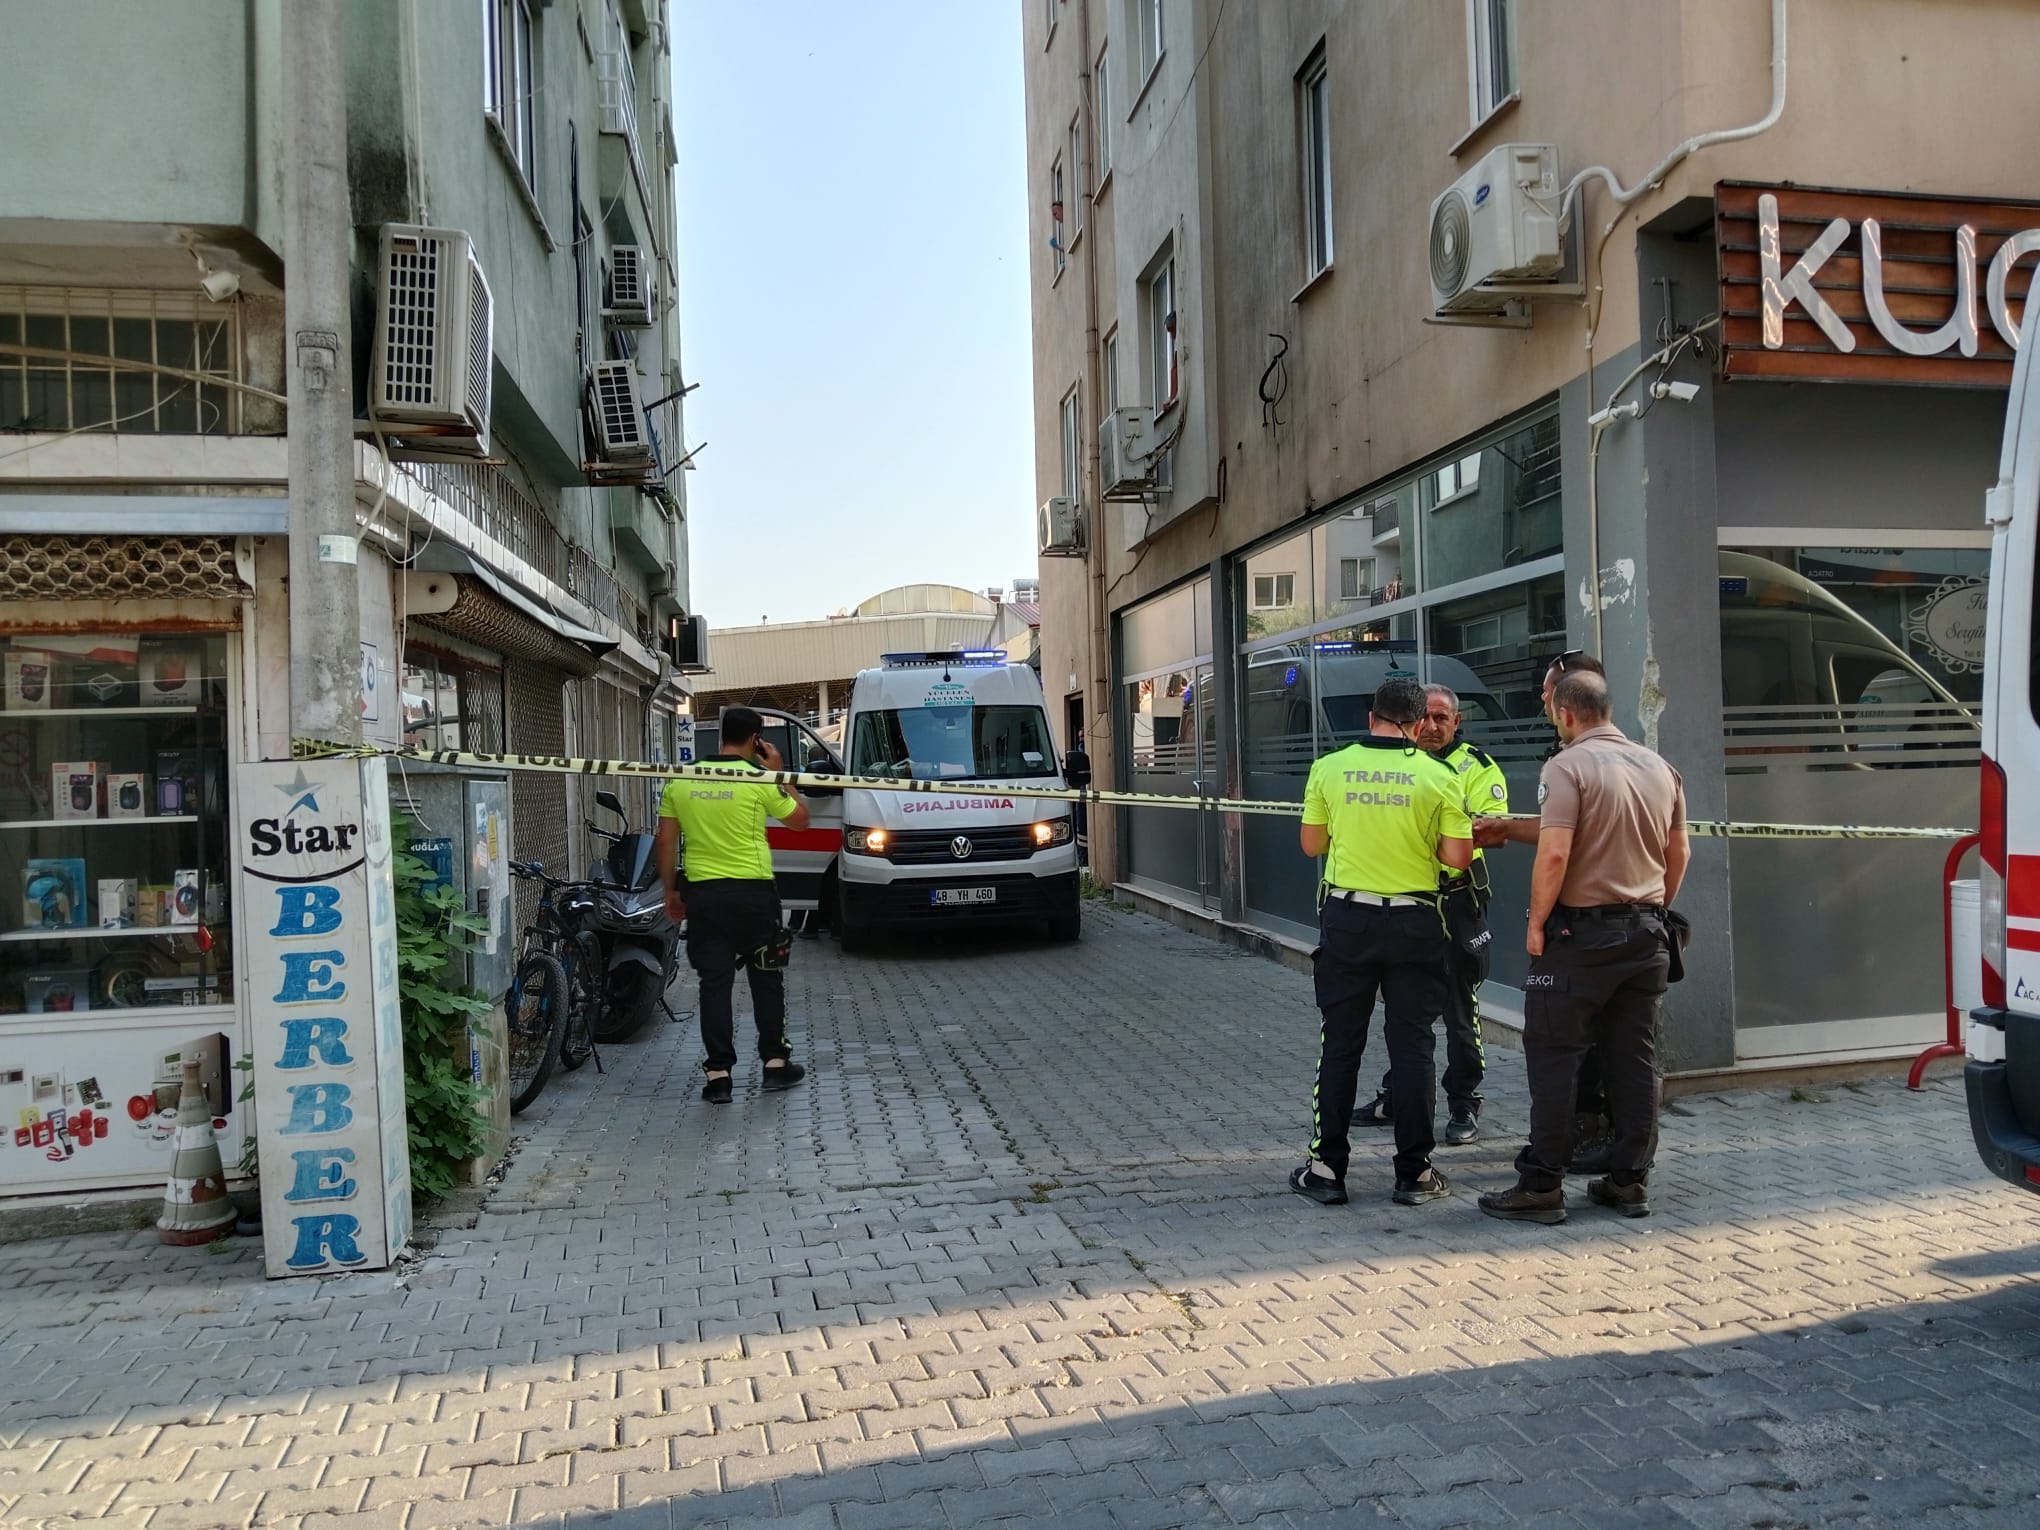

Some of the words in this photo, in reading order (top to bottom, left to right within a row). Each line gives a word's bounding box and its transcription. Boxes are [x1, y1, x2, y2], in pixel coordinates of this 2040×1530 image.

[677, 735, 693, 743] Star
[250, 817, 358, 858] Star
[936, 890, 948, 902] 48
[957, 889, 969, 901] YH
[975, 888, 993, 900] 460
[269, 885, 367, 1270] BERBER
